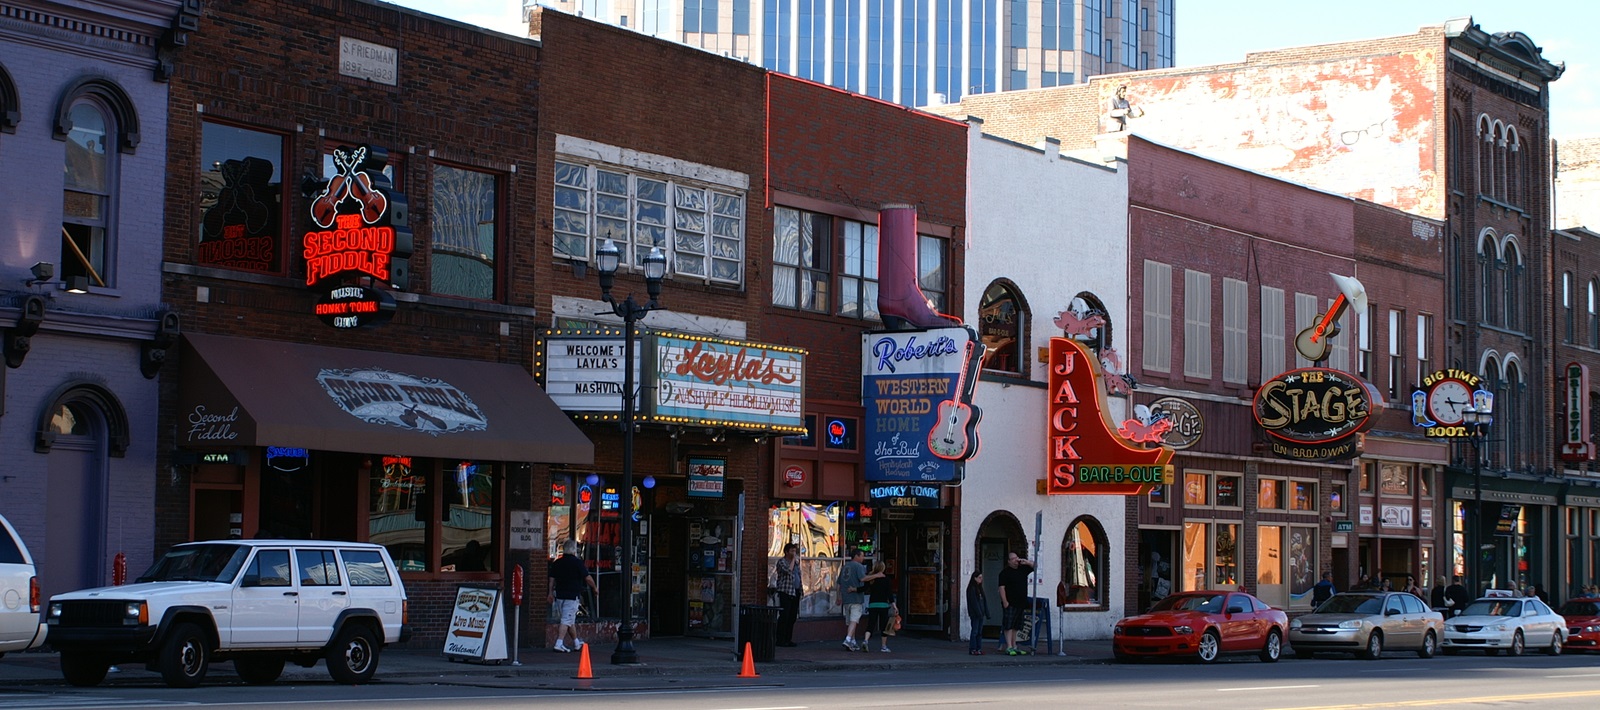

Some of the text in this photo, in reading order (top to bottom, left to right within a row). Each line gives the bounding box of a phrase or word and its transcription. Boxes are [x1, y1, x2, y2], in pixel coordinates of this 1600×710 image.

[336, 213, 362, 229] THE
[303, 226, 394, 260] SECOND
[306, 250, 389, 286] FIDDLE
[331, 287, 363, 300] MUSIC
[316, 301, 377, 315] HONKY TONK
[333, 315, 358, 328] CITY
[566, 345, 613, 356] WELCOME
[873, 335, 958, 374] Robert's
[577, 358, 618, 369] LAYLA'S
[676, 341, 797, 386] Layla's
[377, 372, 393, 381] THE
[1301, 371, 1324, 383] THE
[1423, 368, 1479, 387] BIG TIME
[875, 378, 950, 395] WESTERN
[324, 377, 484, 422] SECOND FIDDLE
[677, 388, 798, 413] NASHVILLE HILLBILLY MUSIC
[875, 398, 931, 415] WORLD
[1169, 401, 1181, 411] THE
[1261, 380, 1368, 430] STAGE
[188, 405, 239, 424] Second
[1052, 350, 1082, 489] JACKS
[187, 422, 238, 442] Fiddle
[876, 418, 920, 433] HOME
[1426, 427, 1475, 437] BOOT
[891, 432, 900, 446] of
[267, 445, 309, 458] SAMUEL
[874, 440, 920, 457] Sho-Bud
[1273, 443, 1351, 458] ON BROADWAY
[203, 454, 229, 462] ATM
[920, 472, 937, 481] GRILL
[1080, 466, 1163, 483] BAR-B-QUE
[870, 485, 940, 499] HONKY TONK
[890, 497, 919, 507] GRILL
[453, 615, 487, 630] Live Music
[449, 642, 480, 655] Welcome!
